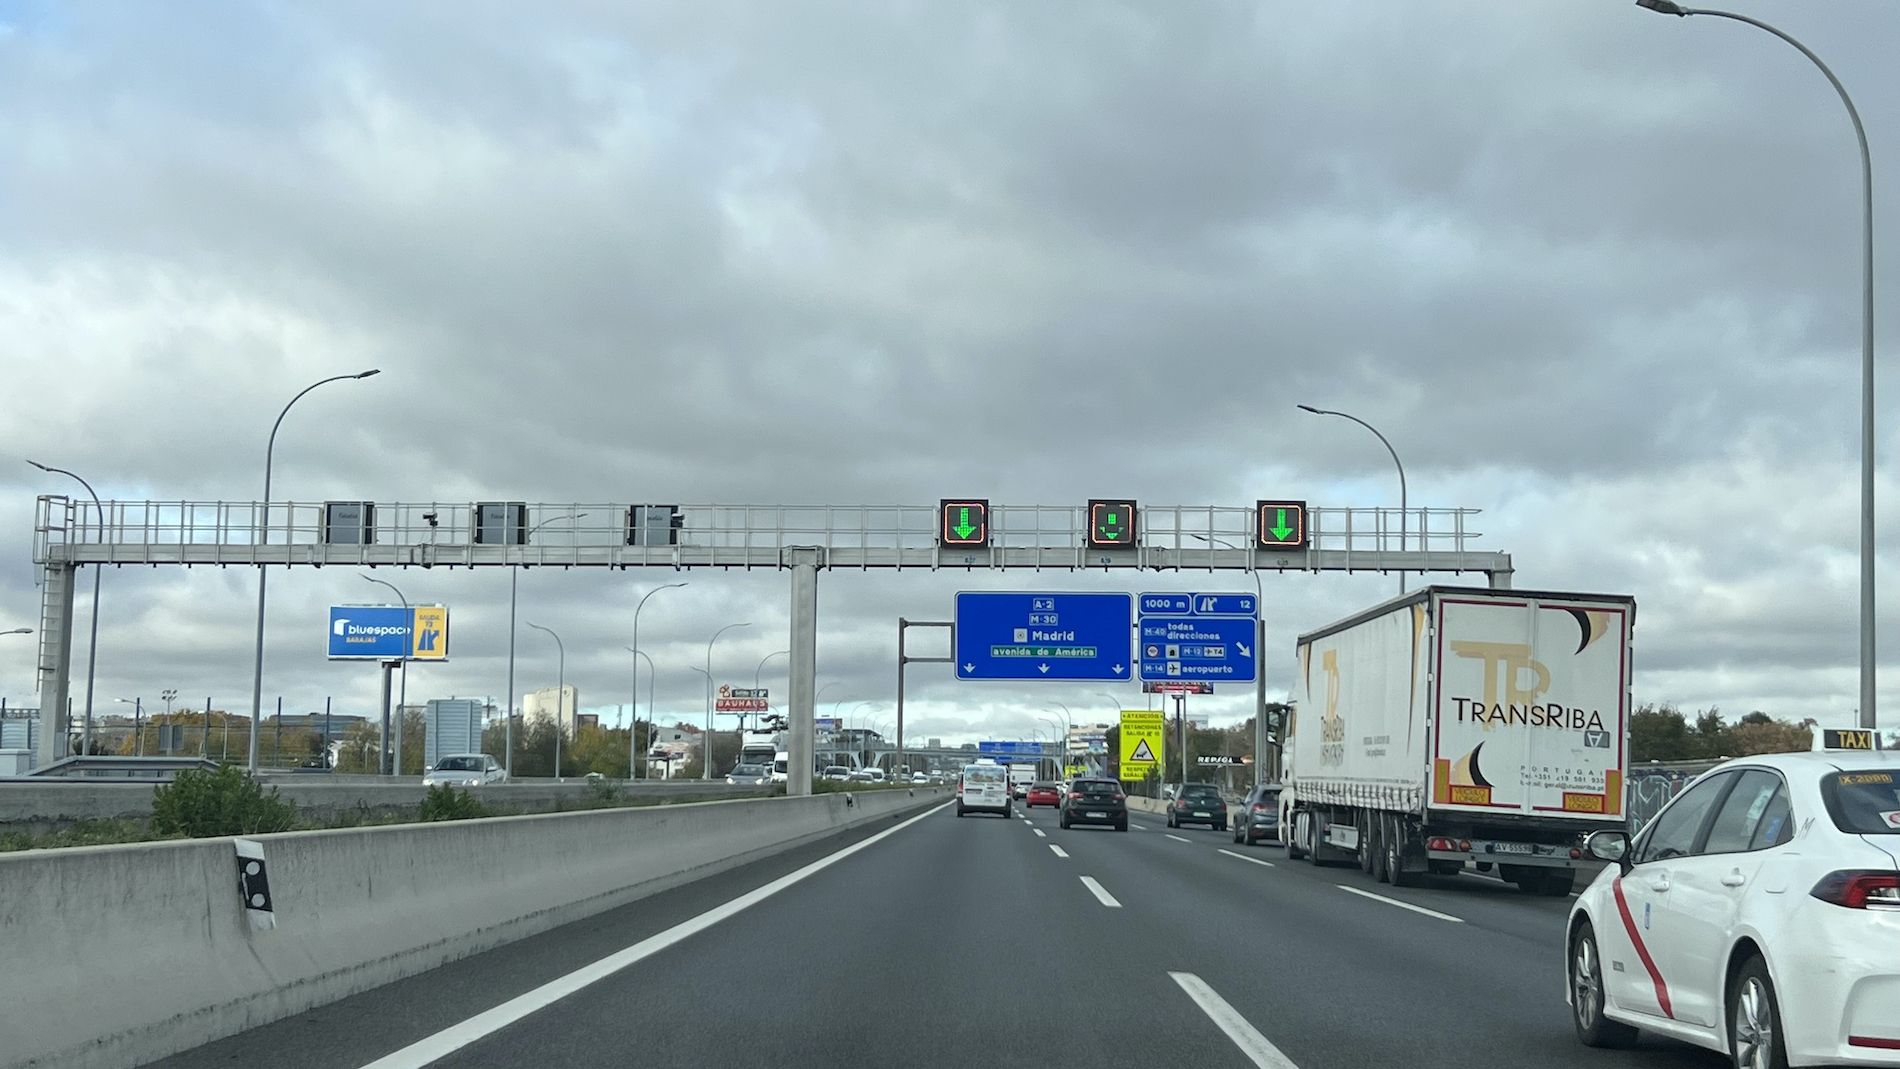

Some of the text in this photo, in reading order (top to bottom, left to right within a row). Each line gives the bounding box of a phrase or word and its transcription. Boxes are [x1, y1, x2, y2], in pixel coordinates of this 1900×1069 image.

[1145, 599, 1186, 609] 1000 m
[1240, 600, 1251, 609] 12
[1030, 615, 1057, 624] M-30
[348, 625, 411, 637] bluespace
[1167, 622, 1194, 631] todas
[1032, 630, 1075, 642] Madrid
[1167, 631, 1221, 640] direcciones
[993, 646, 1095, 657] avenida de América
[1182, 665, 1233, 674] aeropuerto
[717, 700, 766, 708] BAUHAUS
[1837, 731, 1872, 749] TAXI
[1197, 756, 1234, 764] REPSOL
